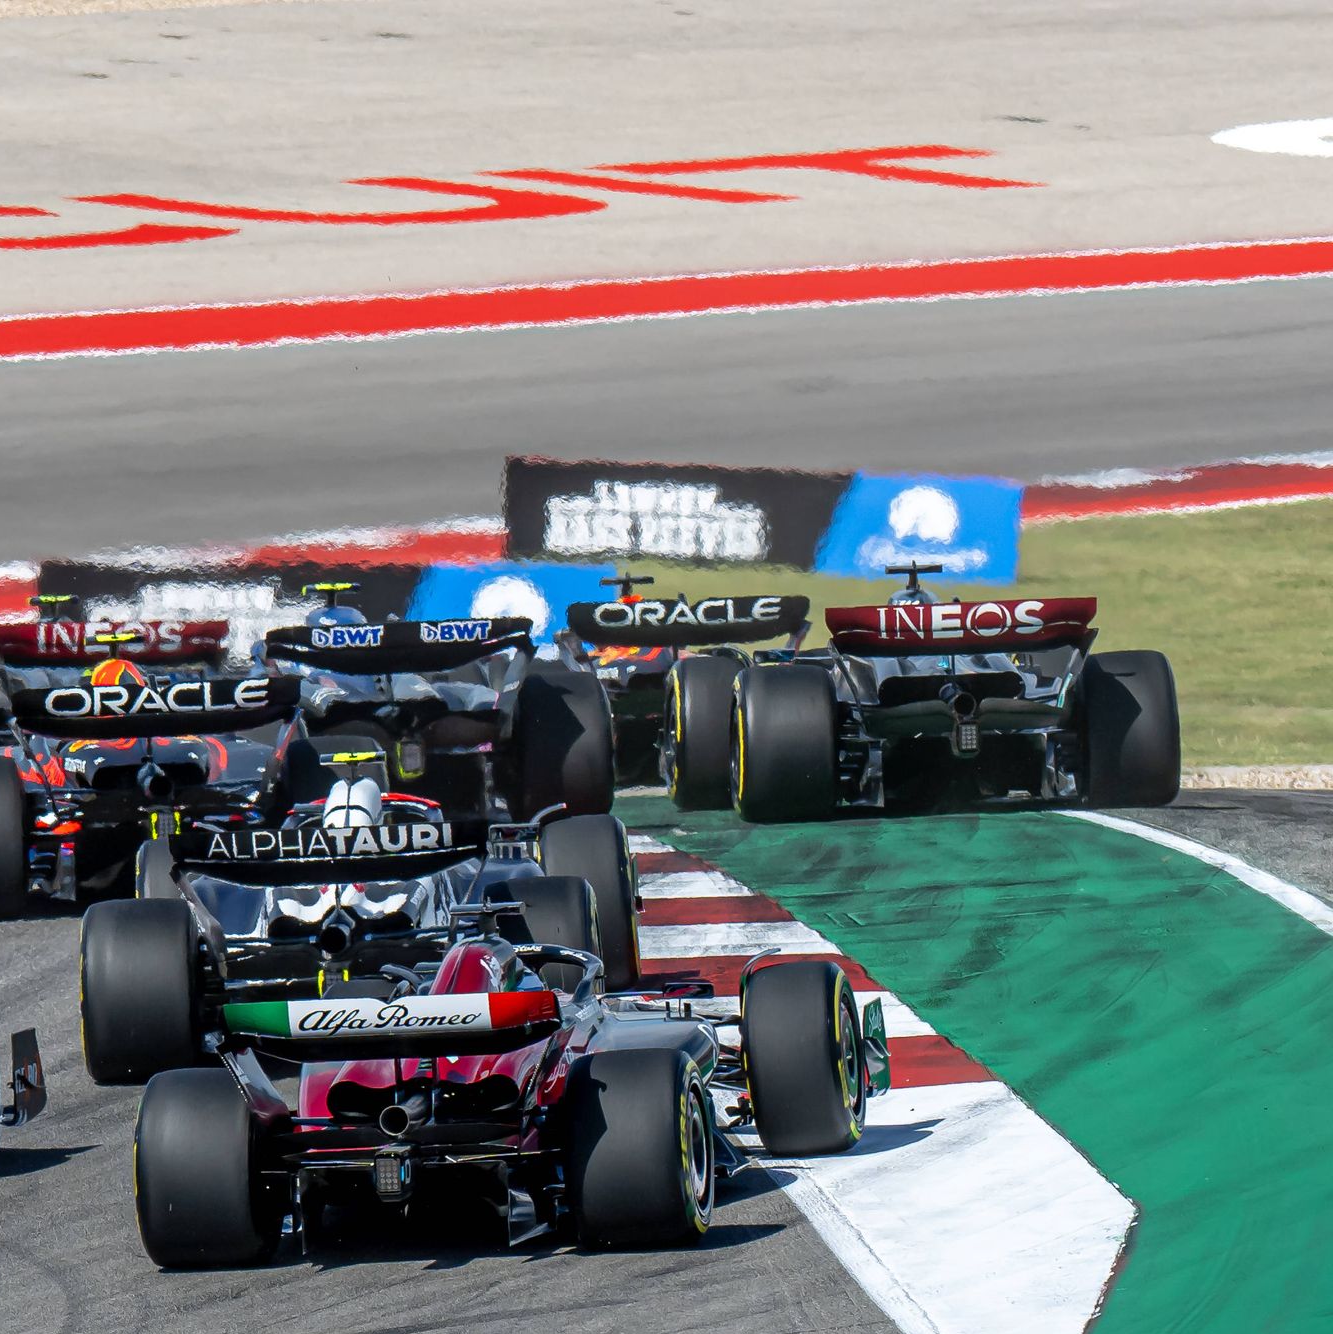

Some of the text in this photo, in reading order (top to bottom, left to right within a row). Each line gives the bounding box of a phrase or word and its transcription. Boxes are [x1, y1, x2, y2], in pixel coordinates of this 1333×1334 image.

[593, 597, 782, 628] ORACLE
[876, 600, 1045, 640] INEOS
[332, 625, 384, 647] BWT
[438, 620, 491, 642] BWT
[45, 678, 270, 717] ORACLE
[208, 823, 452, 859] ALPHATAURI
[298, 1004, 482, 1036] Alfa Romeo
